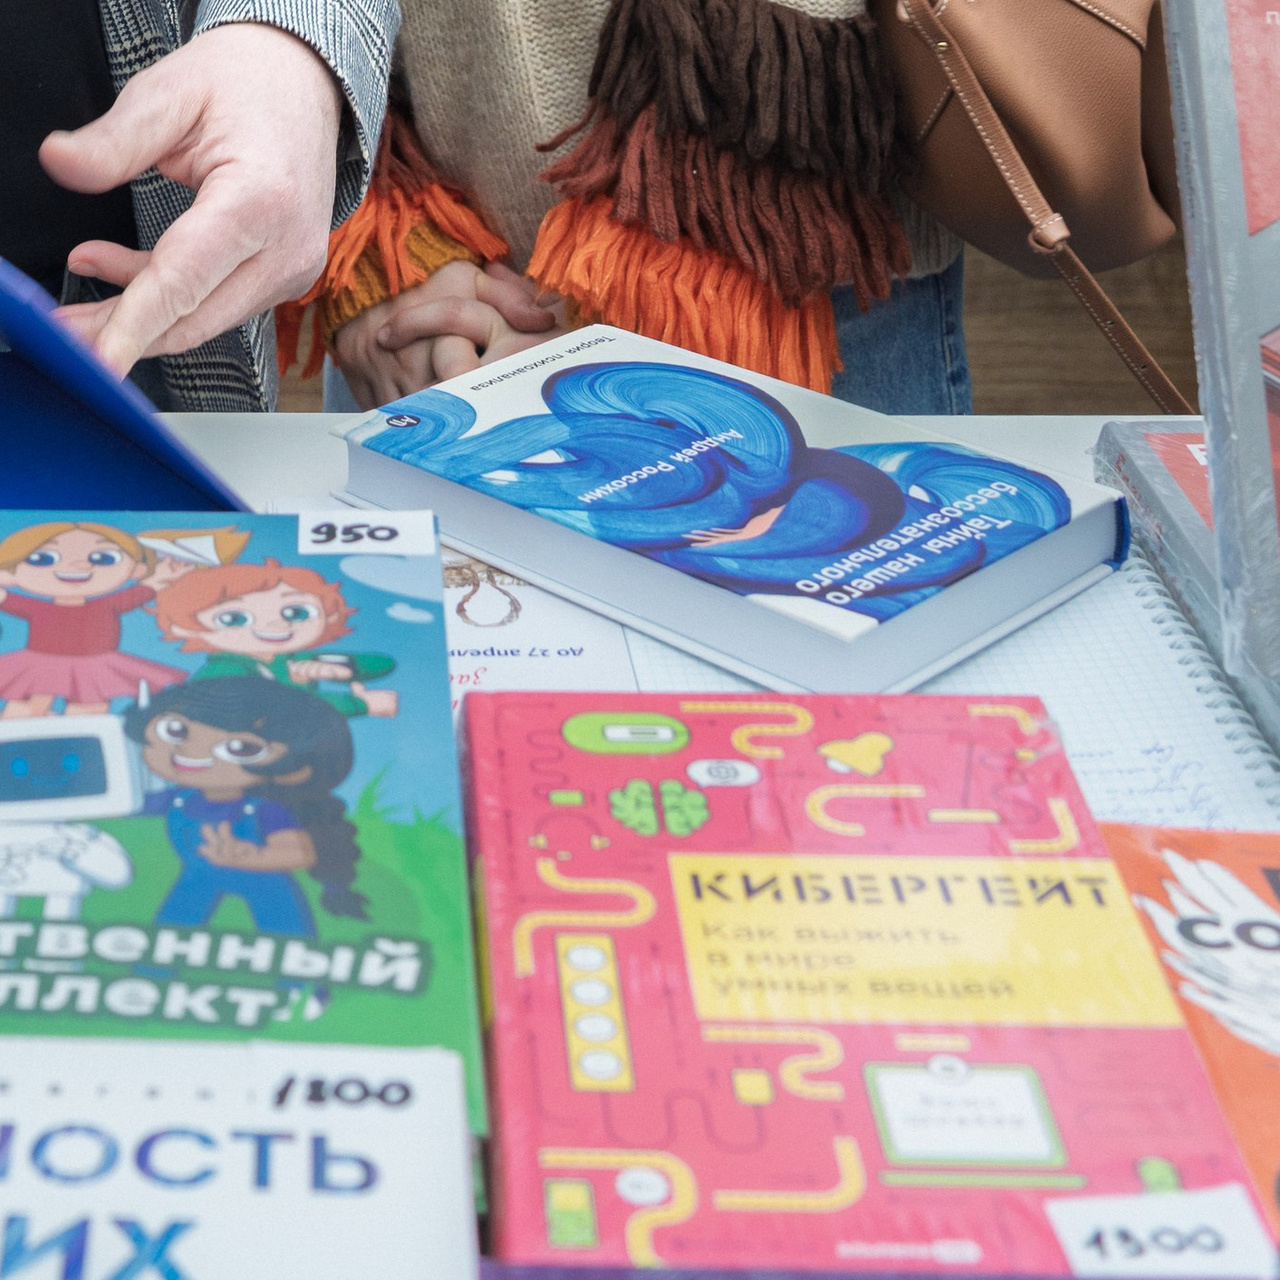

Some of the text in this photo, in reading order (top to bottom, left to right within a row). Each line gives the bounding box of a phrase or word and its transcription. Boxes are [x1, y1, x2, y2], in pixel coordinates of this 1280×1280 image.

[470, 334, 617, 392] Теория психоанализа
[577, 428, 745, 504] Андрей Россохин
[310, 522, 400, 545] 950
[795, 480, 1019, 594] бессознательного
[825, 512, 1013, 605] Тайны нашего
[528, 646, 552, 658] 27
[557, 646, 584, 658] до
[689, 872, 1111, 908] КИБЕРГЕЙТ
[700, 922, 778, 942] Как
[709, 976, 1016, 1001] умных вещей
